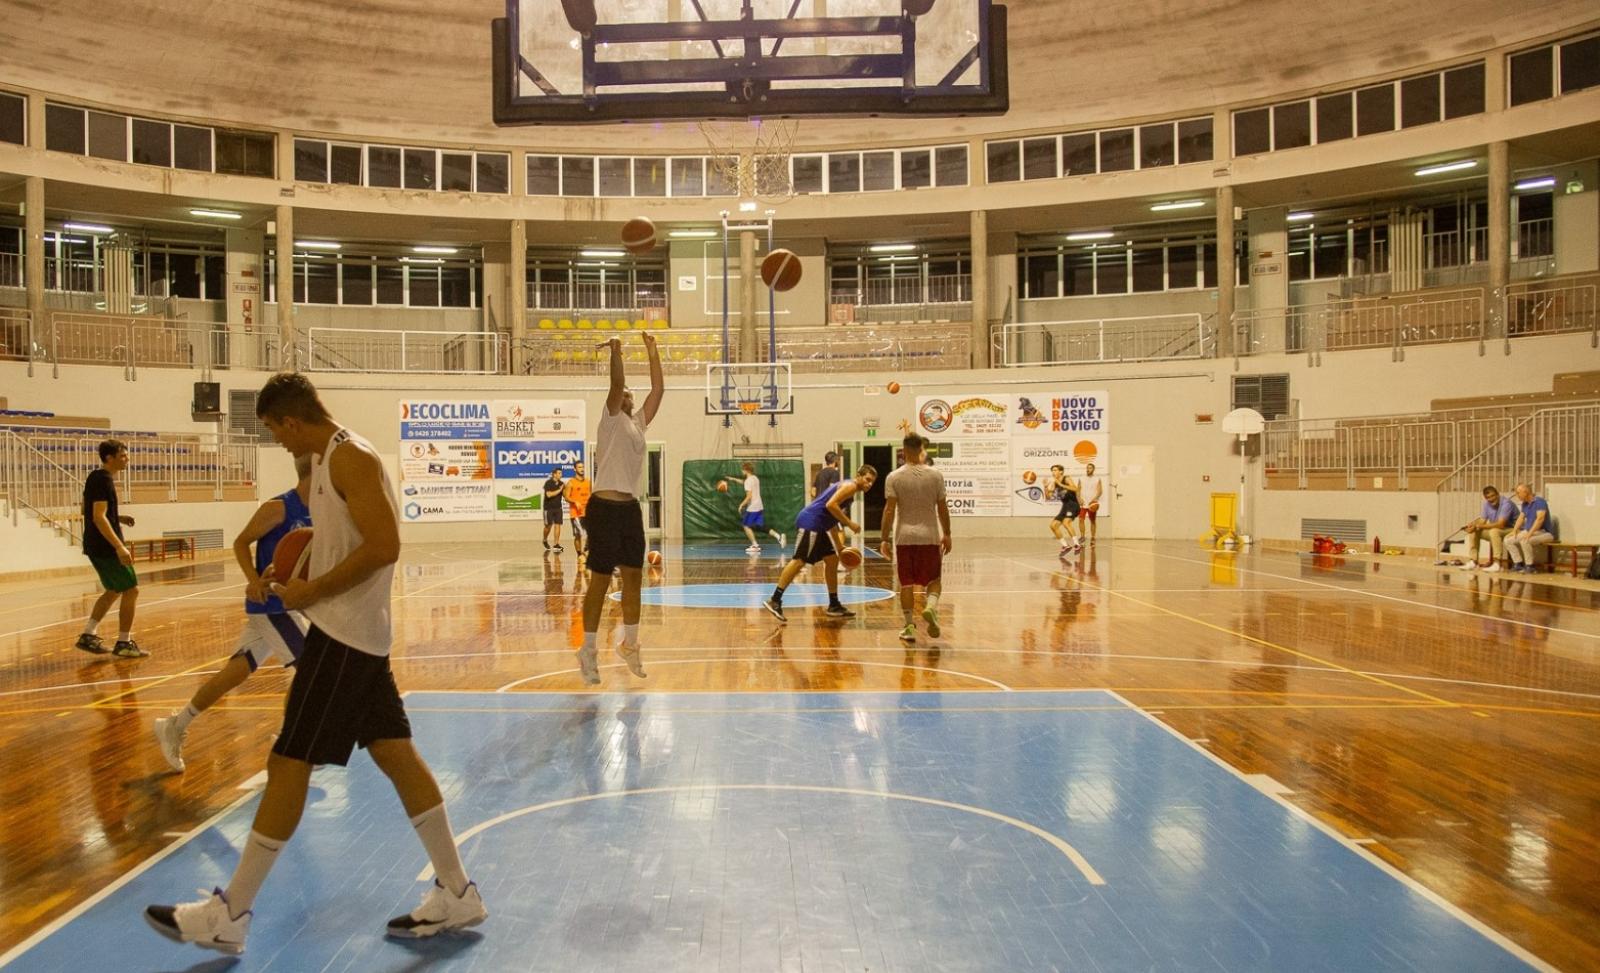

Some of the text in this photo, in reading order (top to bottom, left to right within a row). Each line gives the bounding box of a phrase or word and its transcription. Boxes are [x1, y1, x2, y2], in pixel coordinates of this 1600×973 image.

[1052, 397, 1096, 409] NUOVO
[410, 403, 490, 419] ECOCLIMA
[1052, 409, 1104, 420] BASKET
[497, 421, 535, 432] BASKET
[1052, 420, 1100, 432] ROVIGO
[498, 450, 581, 465] DECATHLON
[1023, 450, 1069, 458] ORIZZONTE
[944, 480, 973, 488] ttoria
[946, 499, 975, 508] CONI
